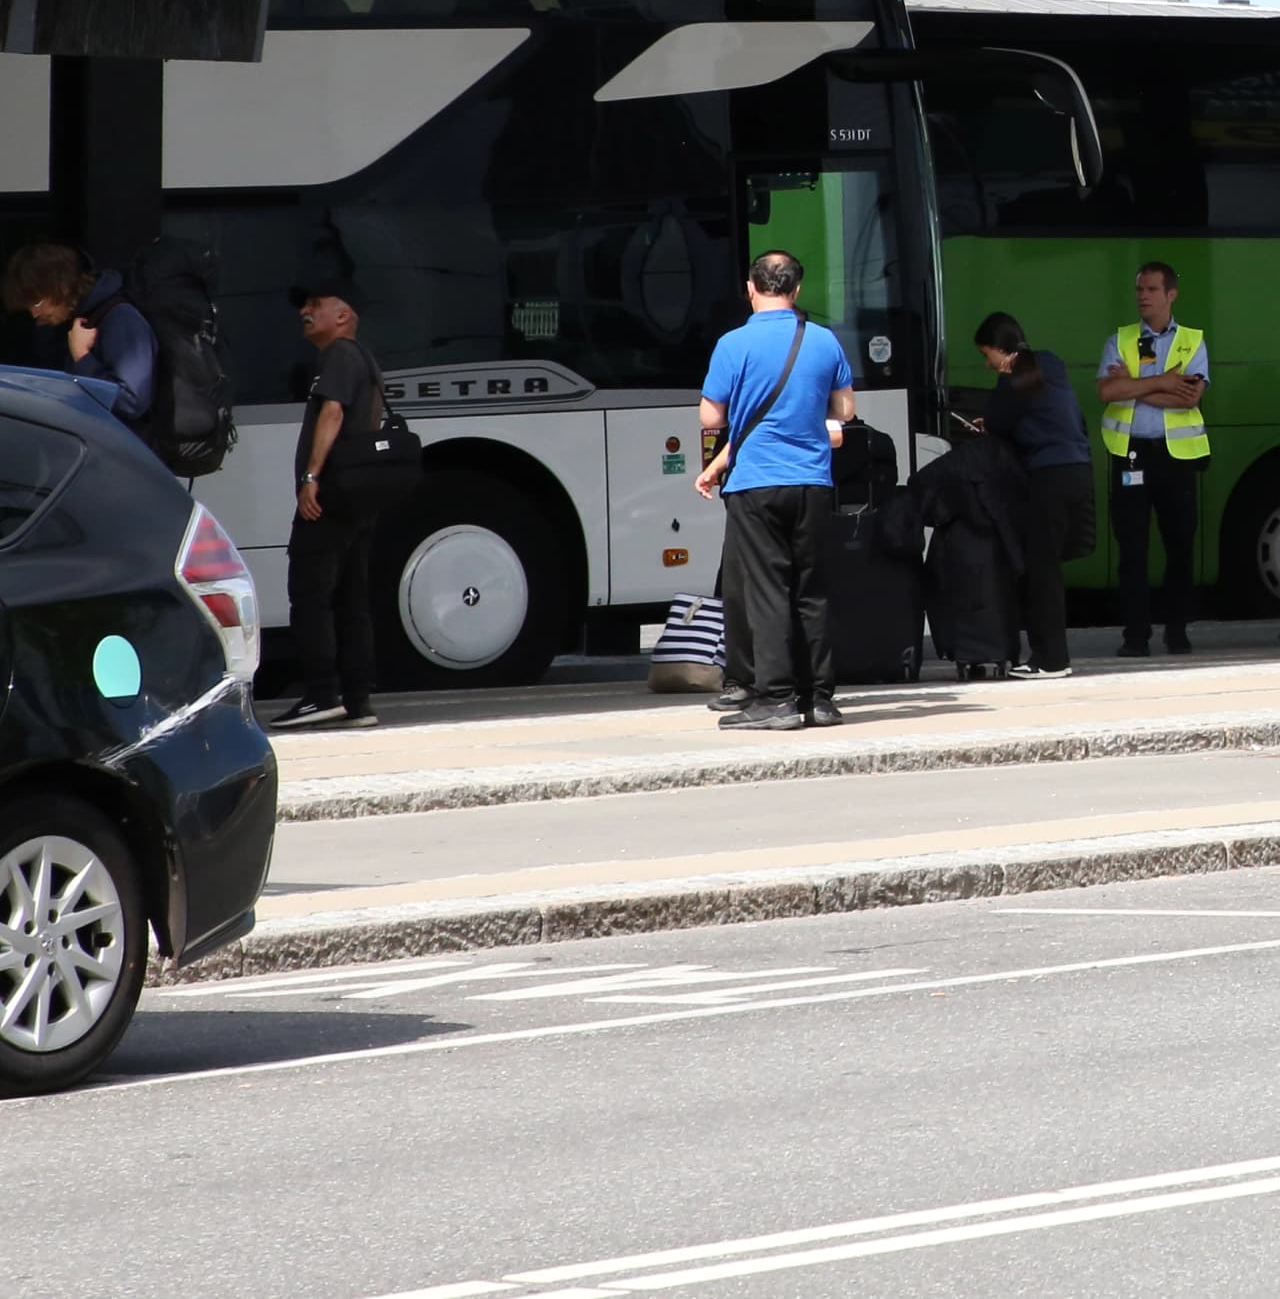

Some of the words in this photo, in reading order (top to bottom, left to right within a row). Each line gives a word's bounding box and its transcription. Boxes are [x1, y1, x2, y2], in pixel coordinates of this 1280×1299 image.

[830, 128, 837, 141] S
[839, 128, 855, 141] 531
[857, 128, 872, 141] DT
[384, 377, 549, 399] SETRA
